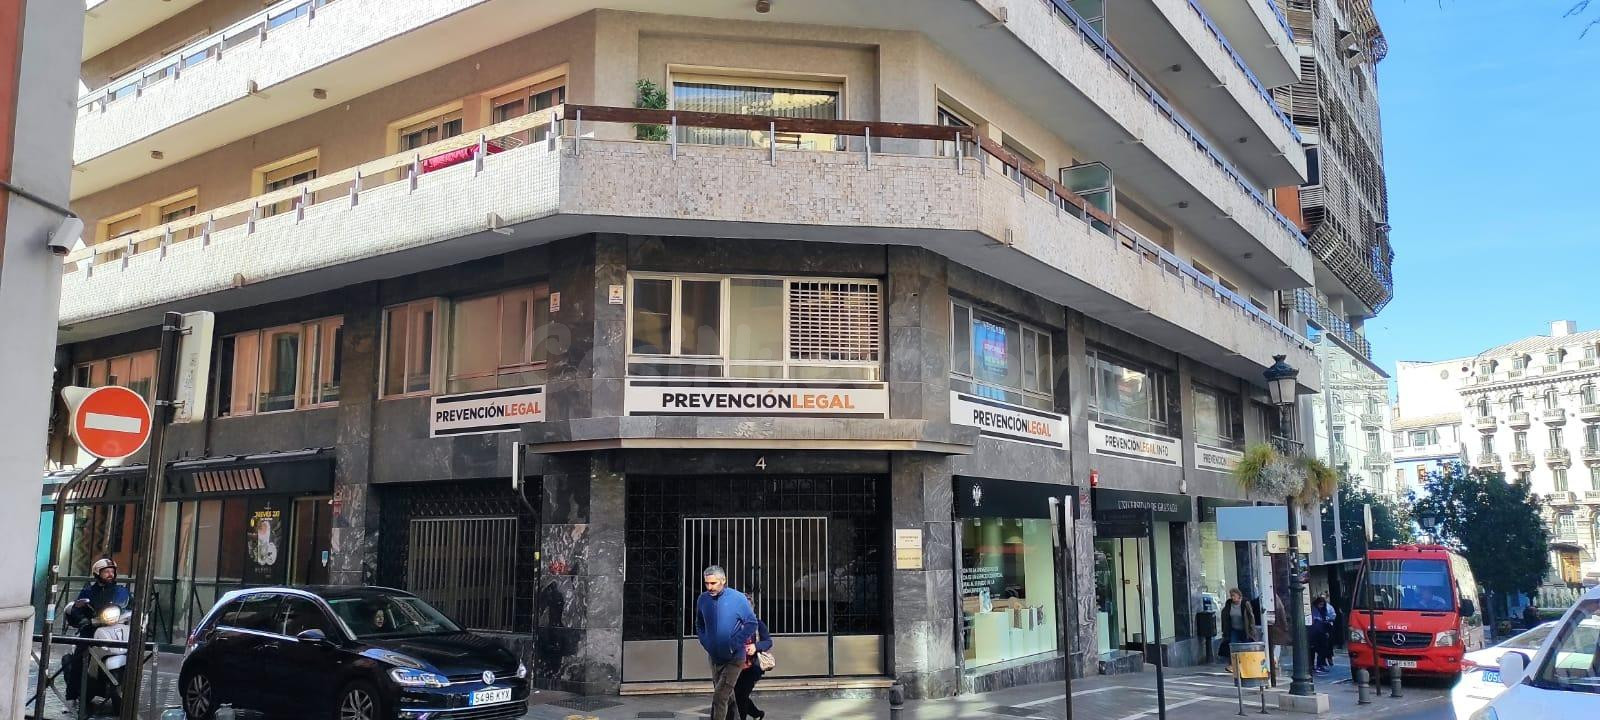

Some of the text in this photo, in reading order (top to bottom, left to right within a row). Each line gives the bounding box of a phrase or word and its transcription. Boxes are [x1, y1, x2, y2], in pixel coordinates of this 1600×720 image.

[662, 389, 855, 409] PREVENCIÓNLEGAL
[436, 402, 541, 422] PREVENCIÓNLEGAL
[755, 456, 767, 471] 4
